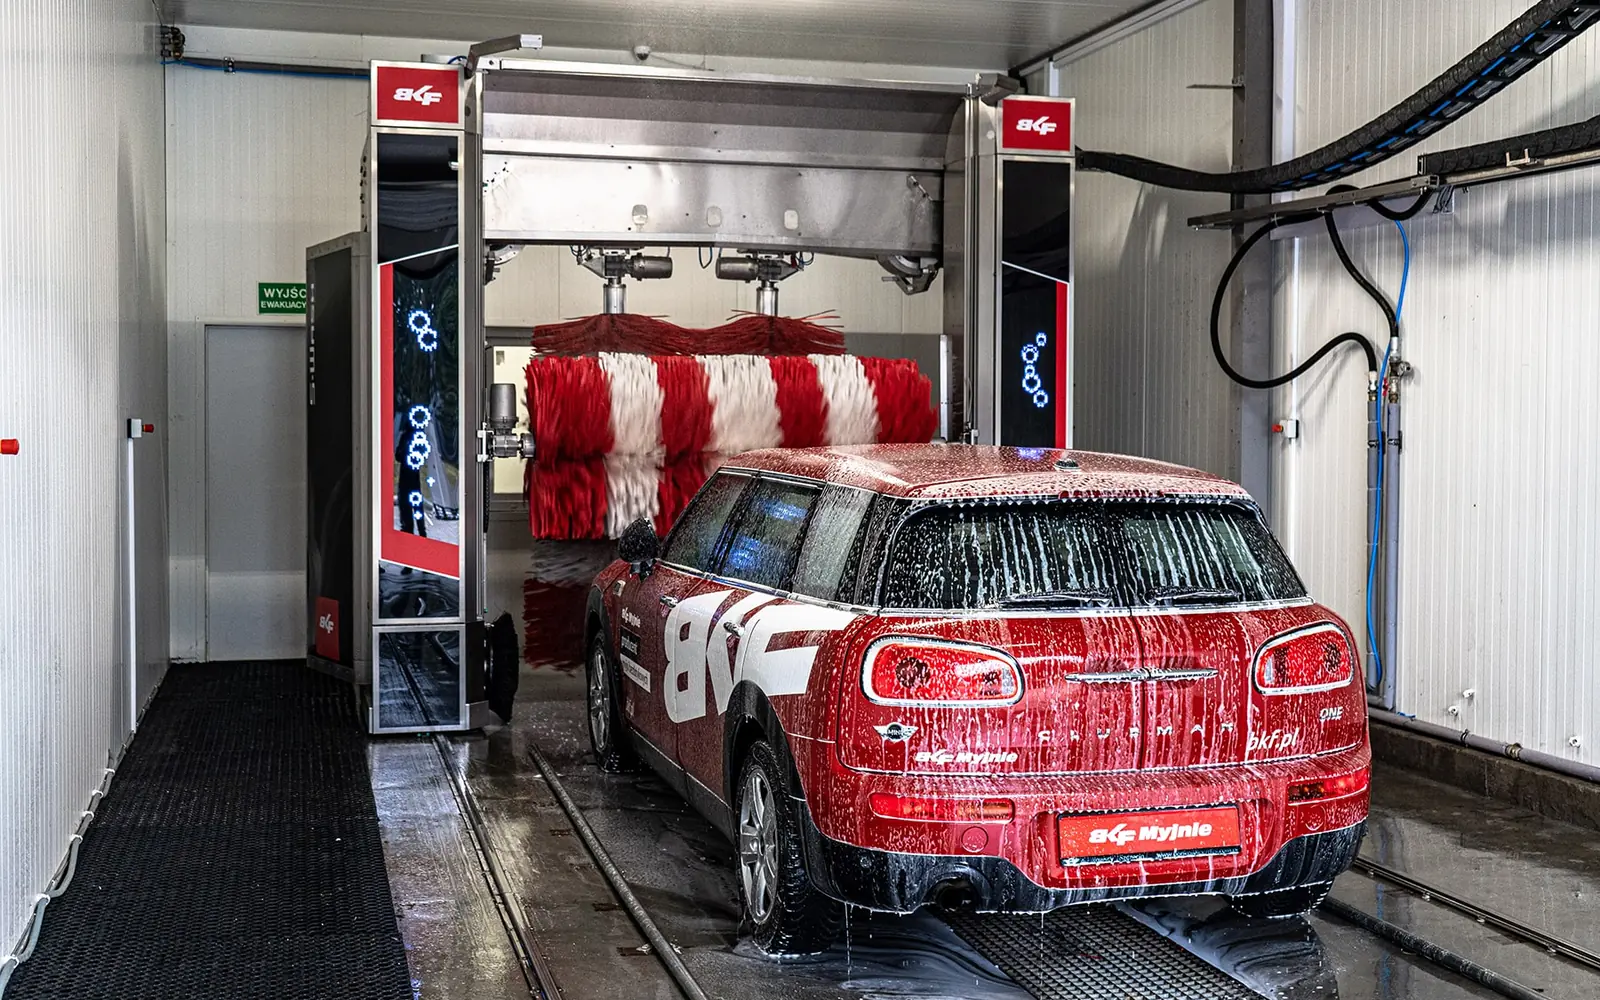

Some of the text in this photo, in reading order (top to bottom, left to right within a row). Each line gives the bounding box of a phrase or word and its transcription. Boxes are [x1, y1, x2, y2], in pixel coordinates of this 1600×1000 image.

[393, 85, 442, 106] BKF
[1016, 116, 1057, 135] BKF
[319, 613, 334, 634] BKF
[663, 589, 852, 723] BKF
[1319, 706, 1344, 721] ONE
[1246, 727, 1299, 752] bkf.pl
[915, 749, 953, 764] BKF
[1088, 822, 1212, 846] BKF Myjnie
